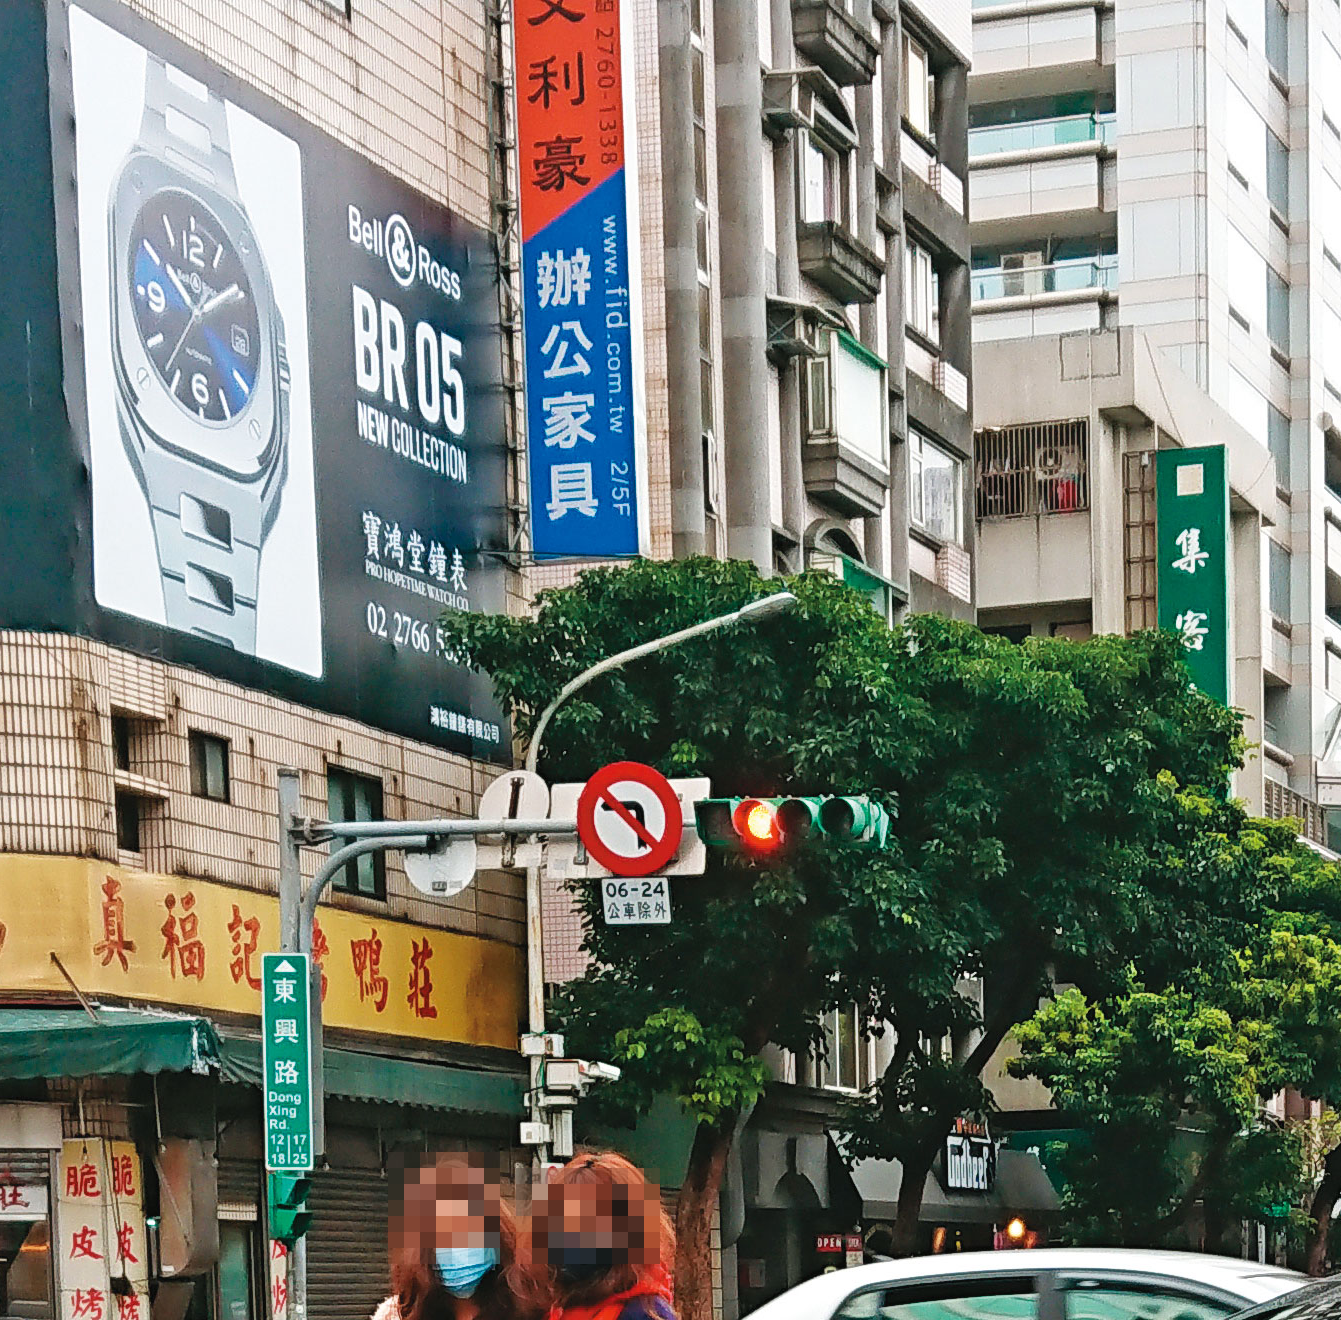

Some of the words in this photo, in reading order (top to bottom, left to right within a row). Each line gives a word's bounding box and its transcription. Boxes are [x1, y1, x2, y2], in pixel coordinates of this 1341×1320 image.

[594, 26, 619, 166] 2760-1338
[348, 203, 383, 258] Bell
[417, 244, 461, 301] Ross
[602, 214, 629, 434] www.fid.com.tw
[352, 283, 410, 412] BR
[415, 320, 466, 436] 05
[536, 247, 599, 521] 辦公家具
[357, 399, 389, 449] NEW
[390, 414, 468, 486] COLLECTION
[610, 460, 631, 518] 2/5F
[361, 510, 468, 592] 寶鴻堂鐘表
[365, 558, 382, 579] PRO
[383, 566, 427, 597] HOPETIME
[426, 583, 456, 608] WATCH
[366, 602, 388, 638] 02
[393, 611, 430, 653] 2766
[605, 881, 665, 898] 06-24
[607, 900, 667, 920] 公車除外
[272, 976, 300, 1086] 東興路
[268, 1091, 302, 1106] Dong
[268, 1105, 298, 1119] Xing
[269, 1119, 291, 1131] Rd.
[270, 1134, 285, 1146] 12
[293, 1134, 307, 1146] 17
[271, 1153, 286, 1165] 18
[292, 1153, 308, 1165] 25
[817, 1237, 842, 1248] OPEN
